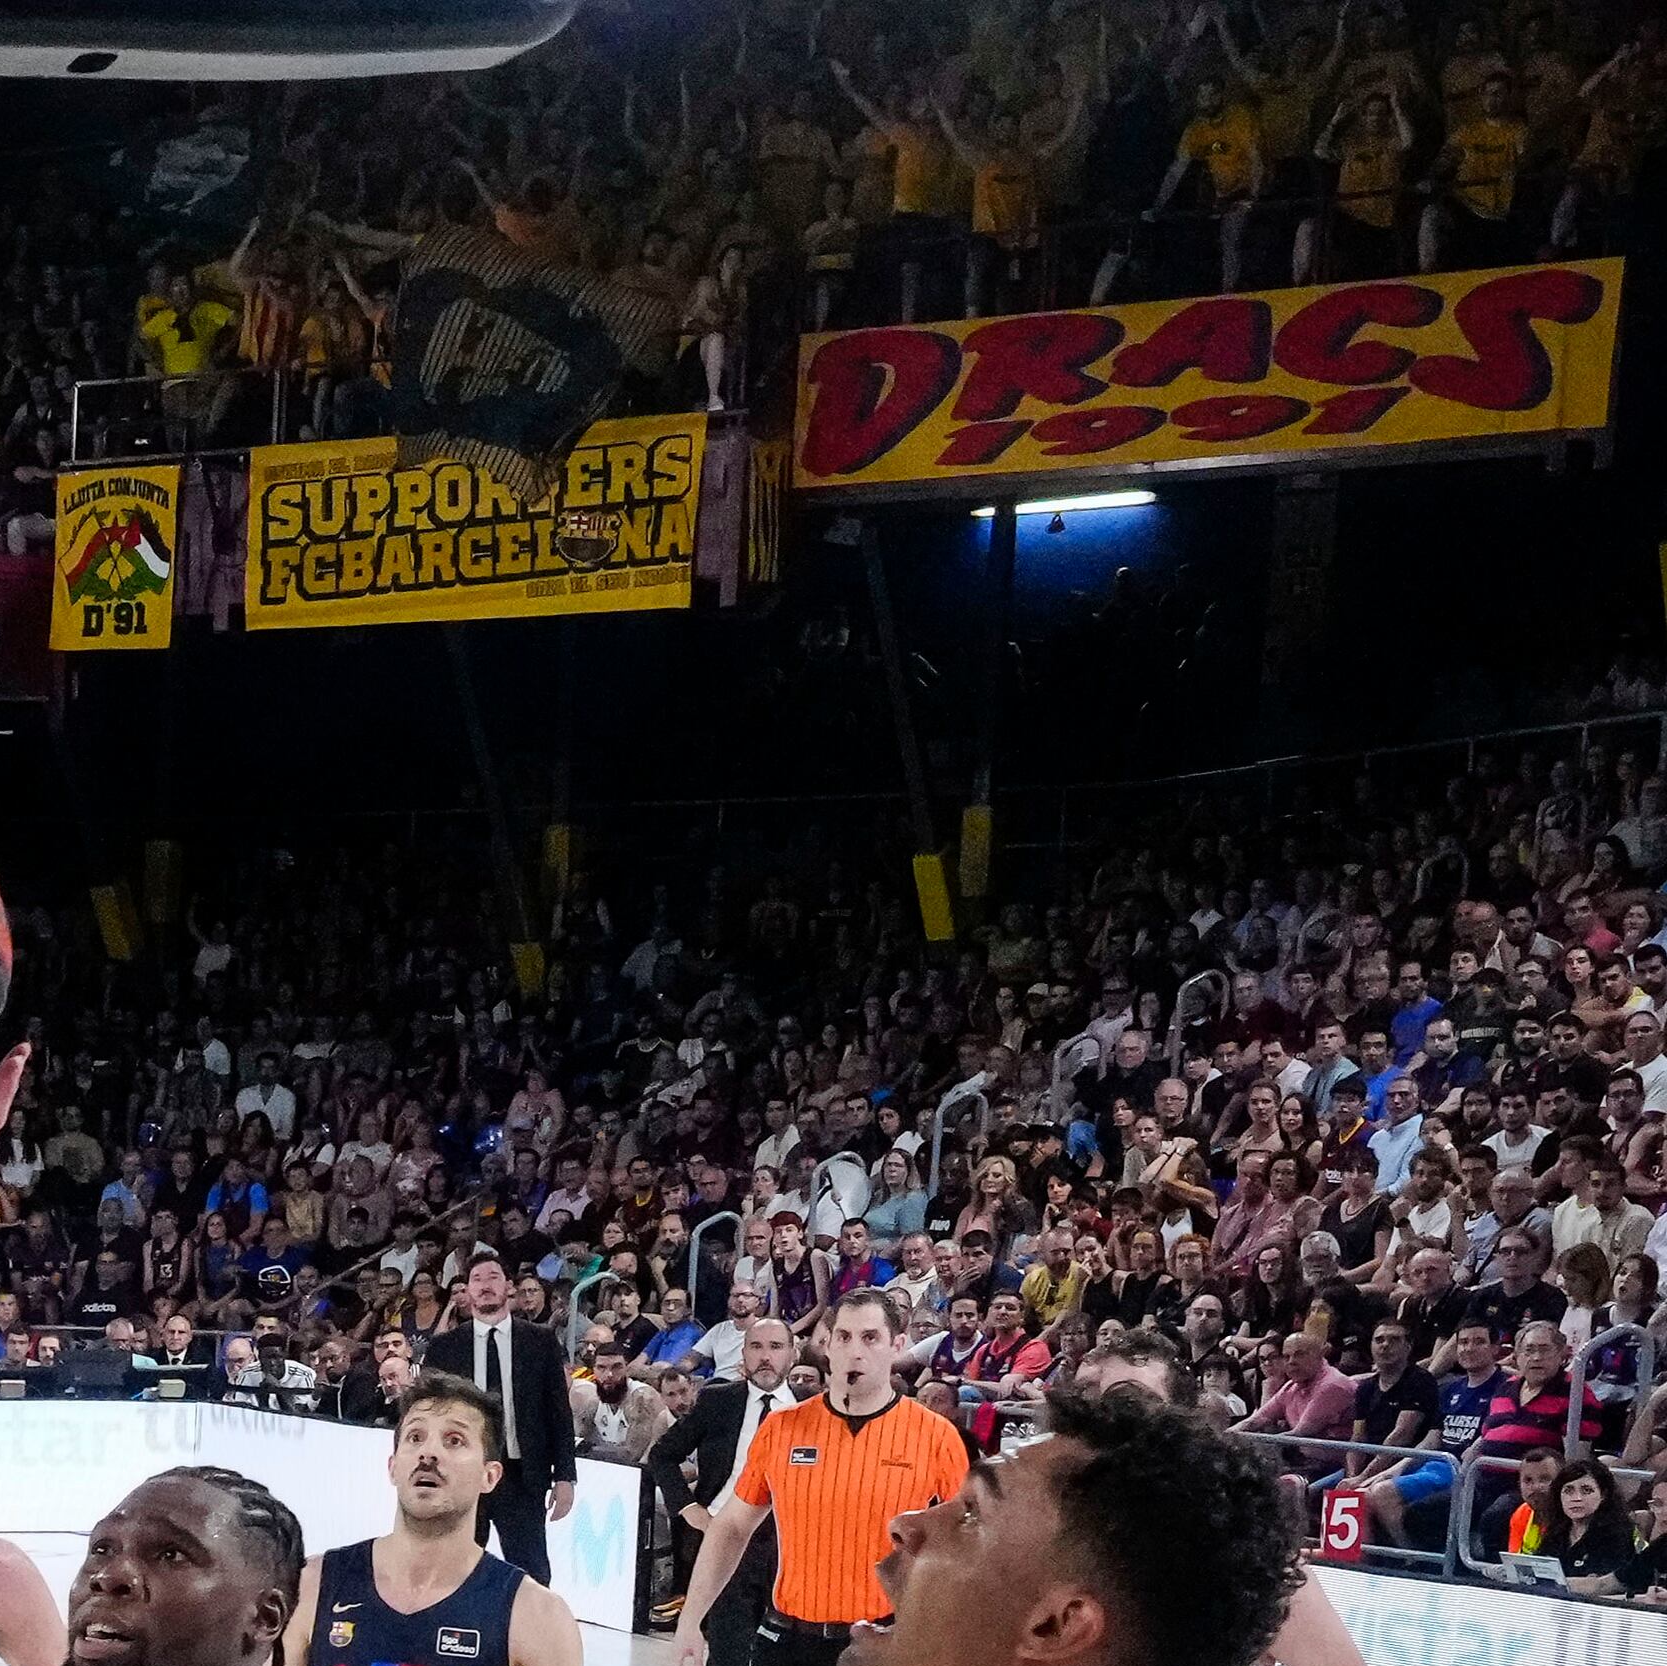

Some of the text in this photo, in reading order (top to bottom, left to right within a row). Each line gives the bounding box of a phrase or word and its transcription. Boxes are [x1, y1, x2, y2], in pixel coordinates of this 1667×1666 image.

[801, 268, 1603, 478] DRACS
[935, 386, 1411, 466] 1991
[261, 433, 694, 546] SUPPORERS
[81, 601, 148, 637] D'91
[1327, 1497, 1360, 1551] 5
